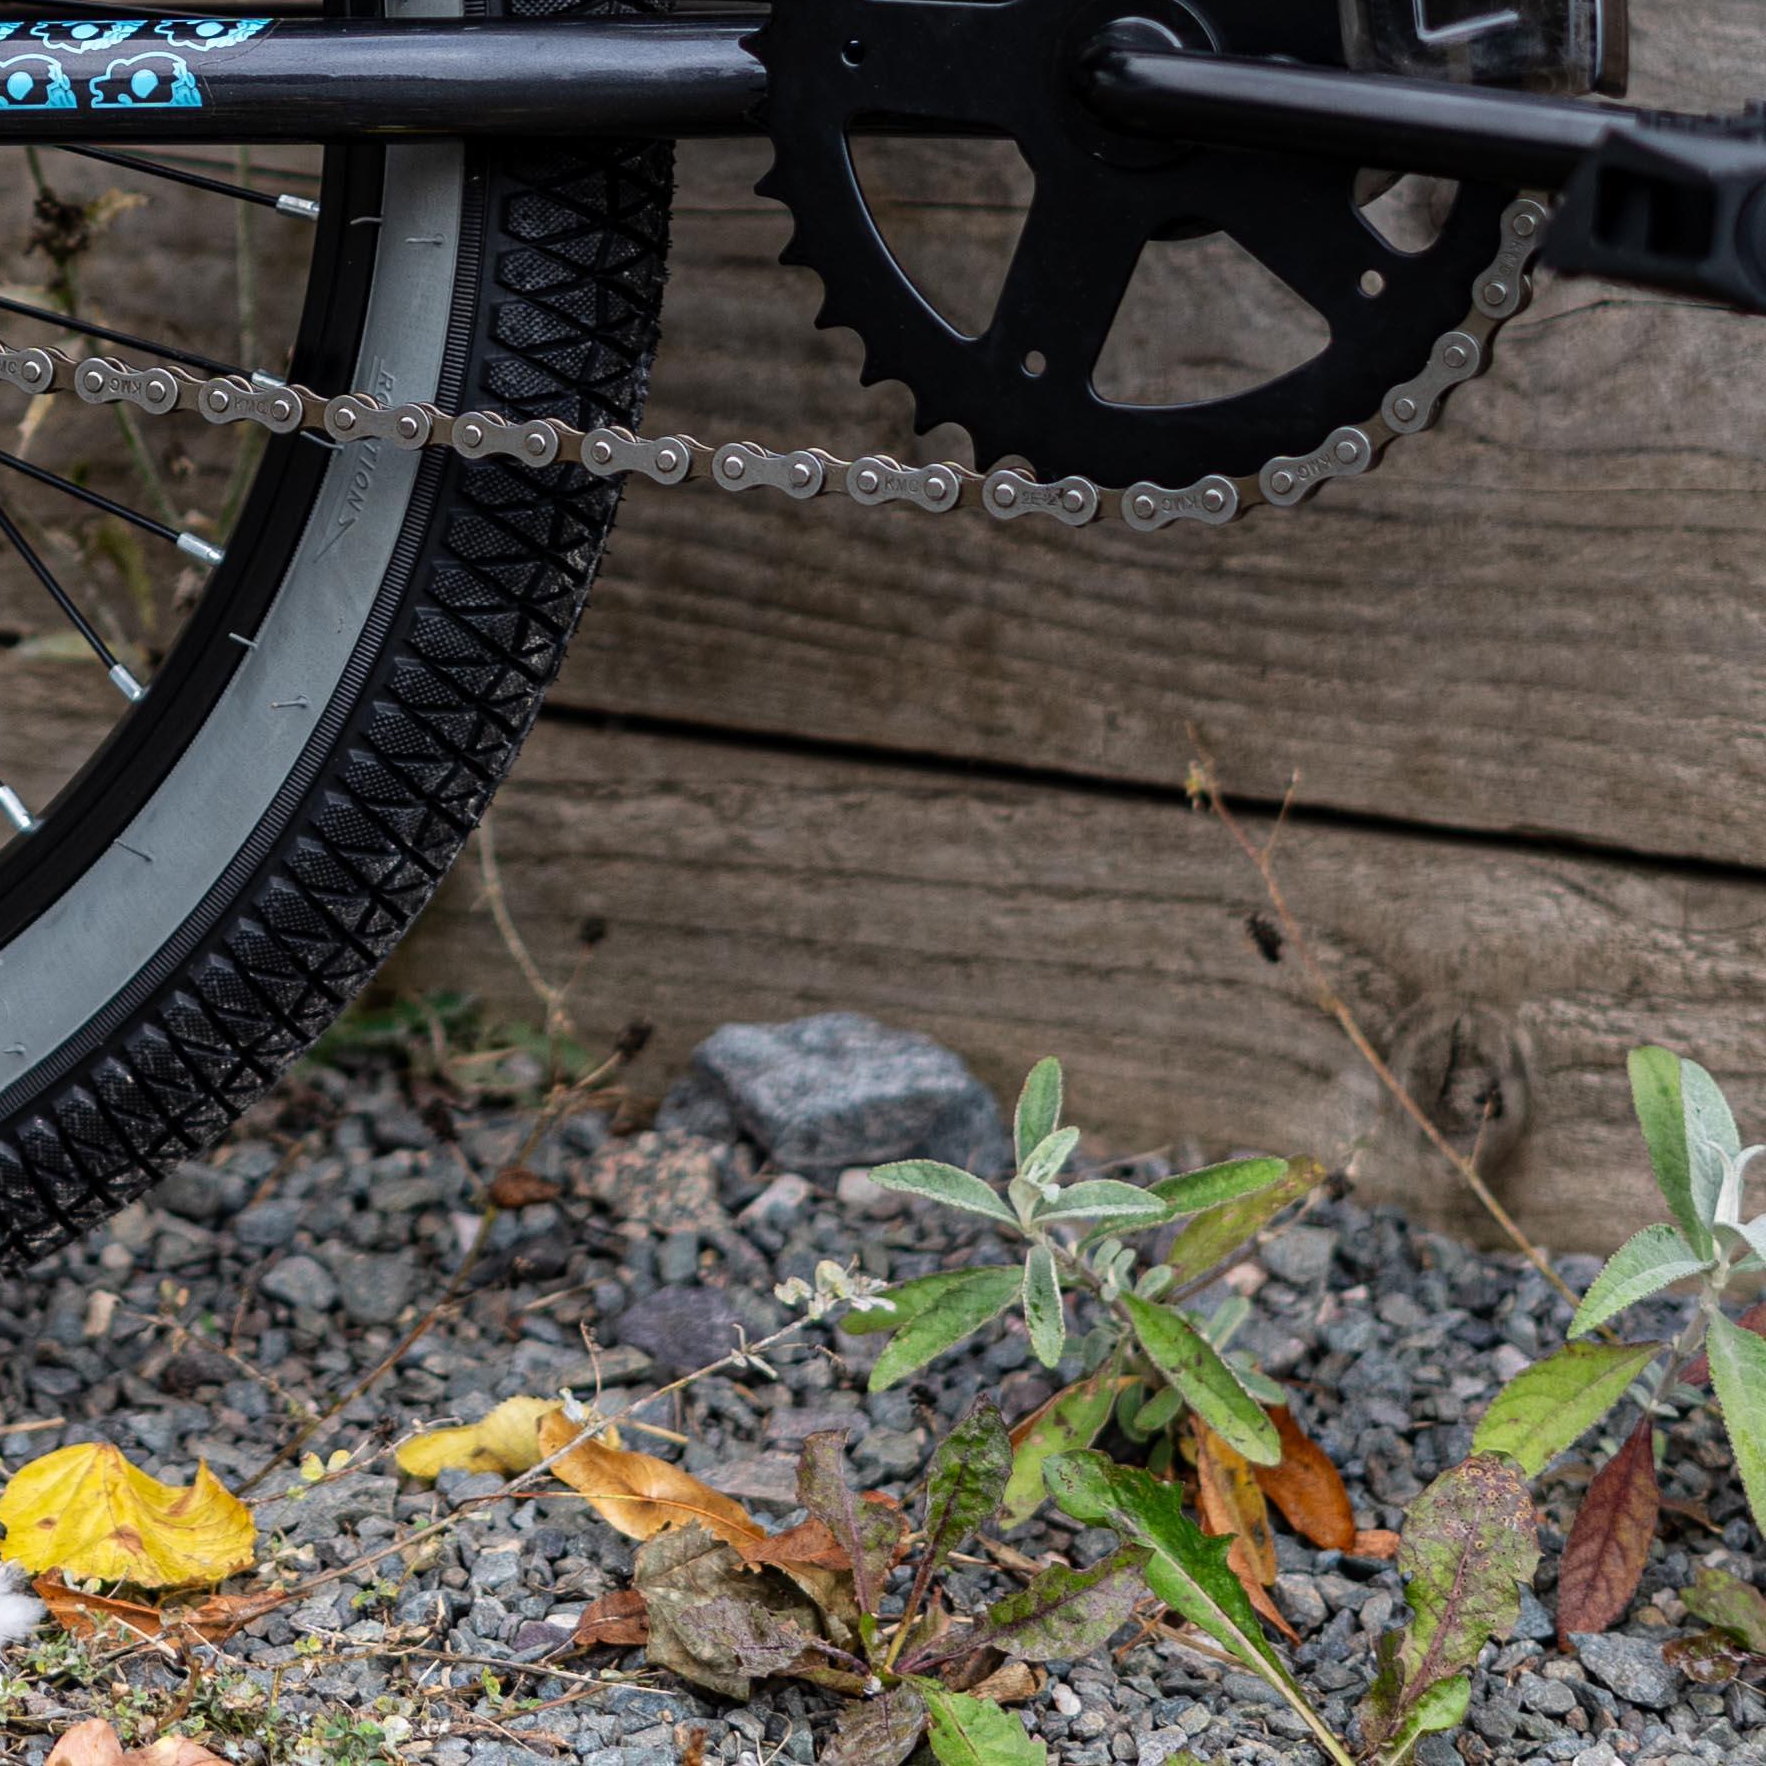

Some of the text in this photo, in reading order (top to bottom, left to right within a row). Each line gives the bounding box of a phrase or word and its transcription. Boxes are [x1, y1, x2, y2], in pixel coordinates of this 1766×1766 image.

[109, 377, 142, 396] KMC
[346, 359, 397, 513] ROTION
[884, 476, 919, 495] KMC
